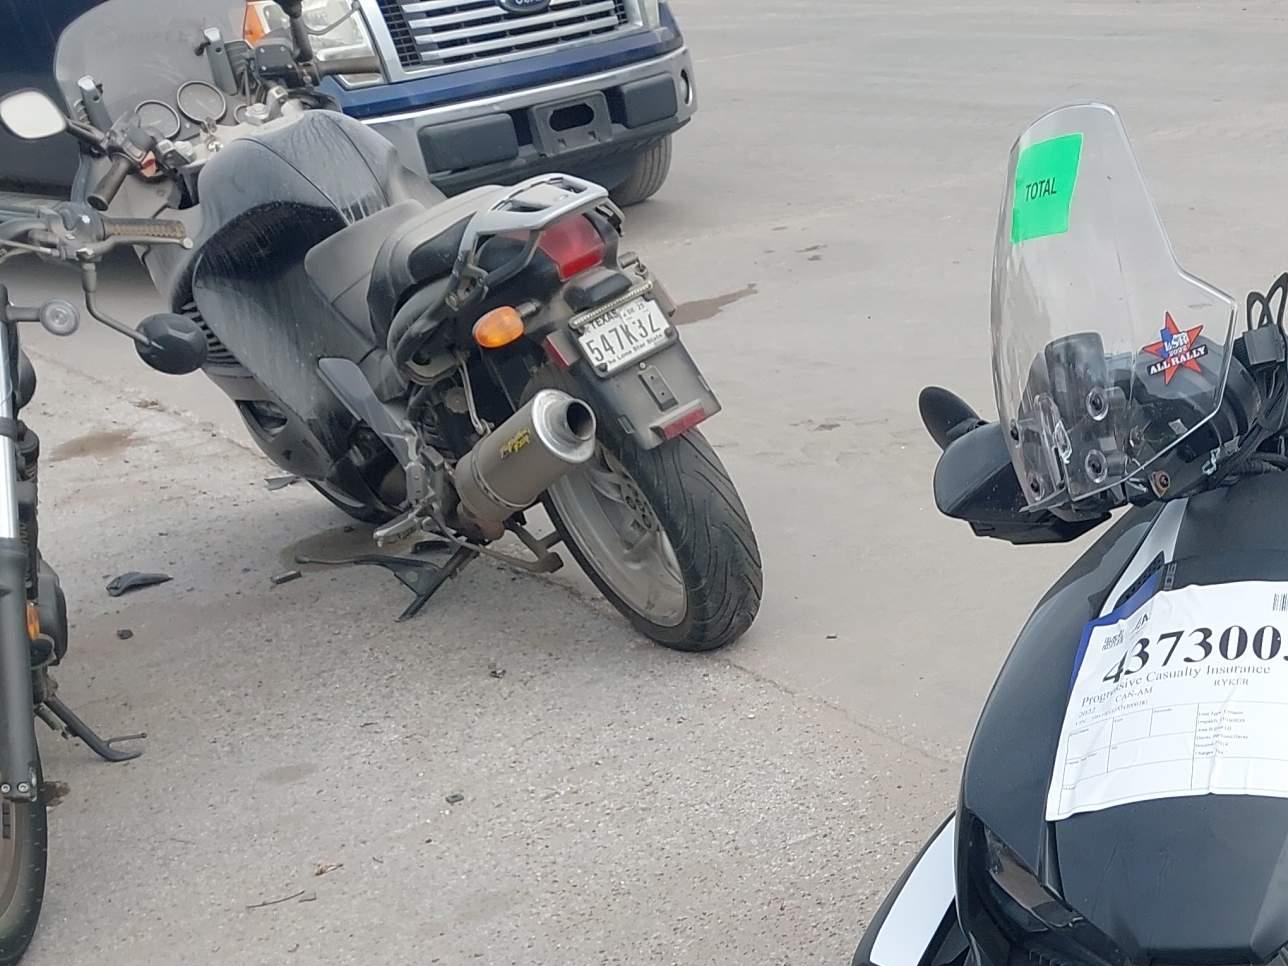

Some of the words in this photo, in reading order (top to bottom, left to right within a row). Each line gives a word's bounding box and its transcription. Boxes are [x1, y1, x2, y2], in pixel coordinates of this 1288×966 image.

[1025, 177, 1057, 201] TOTAL
[1164, 332, 1188, 351] LSR
[1150, 360, 1170, 375] ALL
[1171, 345, 1206, 366] RALLY
[1147, 665, 1201, 682] Casualty
[1206, 665, 1271, 675] Insurance
[1213, 678, 1249, 687] RYKER
